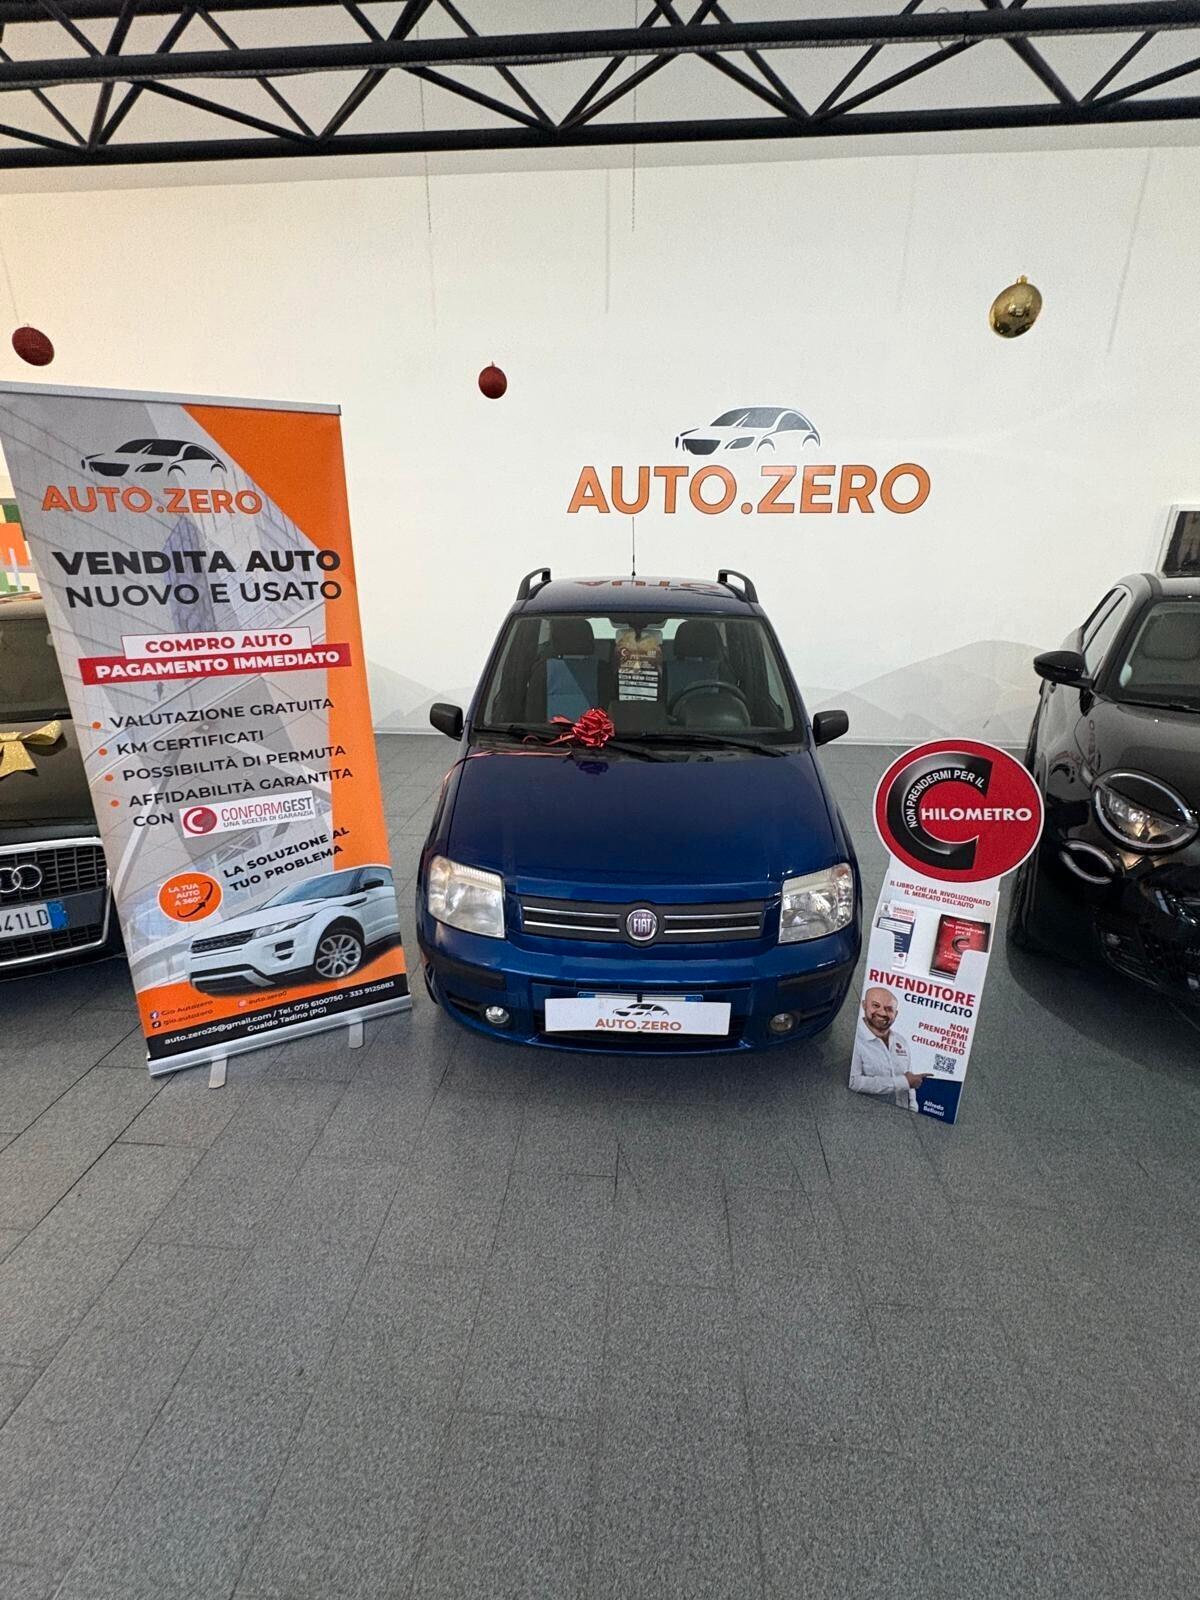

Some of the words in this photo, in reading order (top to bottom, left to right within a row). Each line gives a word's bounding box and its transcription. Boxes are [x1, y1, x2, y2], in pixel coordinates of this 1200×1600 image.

[41, 485, 264, 515] AUTO.ZERO
[566, 463, 931, 515] AUTO.ZERO
[52, 550, 236, 576] VENDITA
[245, 549, 341, 573] AUTO
[65, 583, 200, 609] NUOVO
[211, 583, 230, 603] E
[240, 580, 343, 602] USATO
[145, 636, 235, 654] COMPRO
[241, 633, 294, 648] AUTO
[95, 658, 229, 679] PAGAMENTO
[234, 650, 341, 670] IMMEDIATO
[110, 705, 245, 729] VALUTAZIONE
[250, 698, 335, 717] GRATUITA
[117, 741, 148, 756] KM
[153, 730, 264, 752] CERTIFICATI
[123, 755, 239, 781] POSSIBILITÀ
[243, 755, 261, 767] DI
[266, 744, 347, 764] PERMUTA
[128, 778, 255, 808] AFFIDABILITÀ
[259, 768, 353, 791] GARANTITA
[906, 769, 951, 807] PRENDERMI
[953, 769, 975, 783] PER
[975, 776, 985, 788] IL
[132, 812, 175, 828] CON
[221, 797, 312, 821] CONFORMGEST
[223, 820, 240, 828] UNA
[242, 816, 267, 825] SCELTA
[277, 809, 314, 820] GARANZIA
[906, 807, 918, 829] NON
[223, 867, 244, 878] LA
[246, 838, 327, 871] SOLUZIONE
[332, 827, 350, 840] AL
[229, 874, 261, 891] TUO
[264, 845, 344, 879] PROBLEMA
[176, 890, 200, 899] AUTO
[896, 881, 915, 890] LIBRO
[940, 889, 991, 906] RIVOLUZIONATO
[911, 890, 941, 902] MERCATO
[0, 908, 49, 932] 41LD
[633, 918, 652, 933] FIAT
[869, 968, 976, 1007] RIVENDITORE
[164, 1013, 272, 1044] auto.zero25@gmail.com
[272, 1010, 277, 1018] /
[278, 1006, 293, 1016] Tel.
[294, 1003, 310, 1011] 075
[310, 994, 344, 1008] 6100750
[349, 990, 364, 998] 333
[903, 992, 973, 1019] CERTIFICATO
[247, 1019, 279, 1032] Gualdo
[279, 1011, 308, 1024] Tadino
[309, 1006, 327, 1017] (PG)
[595, 1018, 682, 1031] AUTO.ZERO
[918, 1021, 968, 1042] PRENDERMI
[949, 1023, 970, 1035] NON
[911, 1034, 965, 1056] CHILOMETRO
[941, 1035, 956, 1046] PER
[959, 1039, 967, 1049] IL
